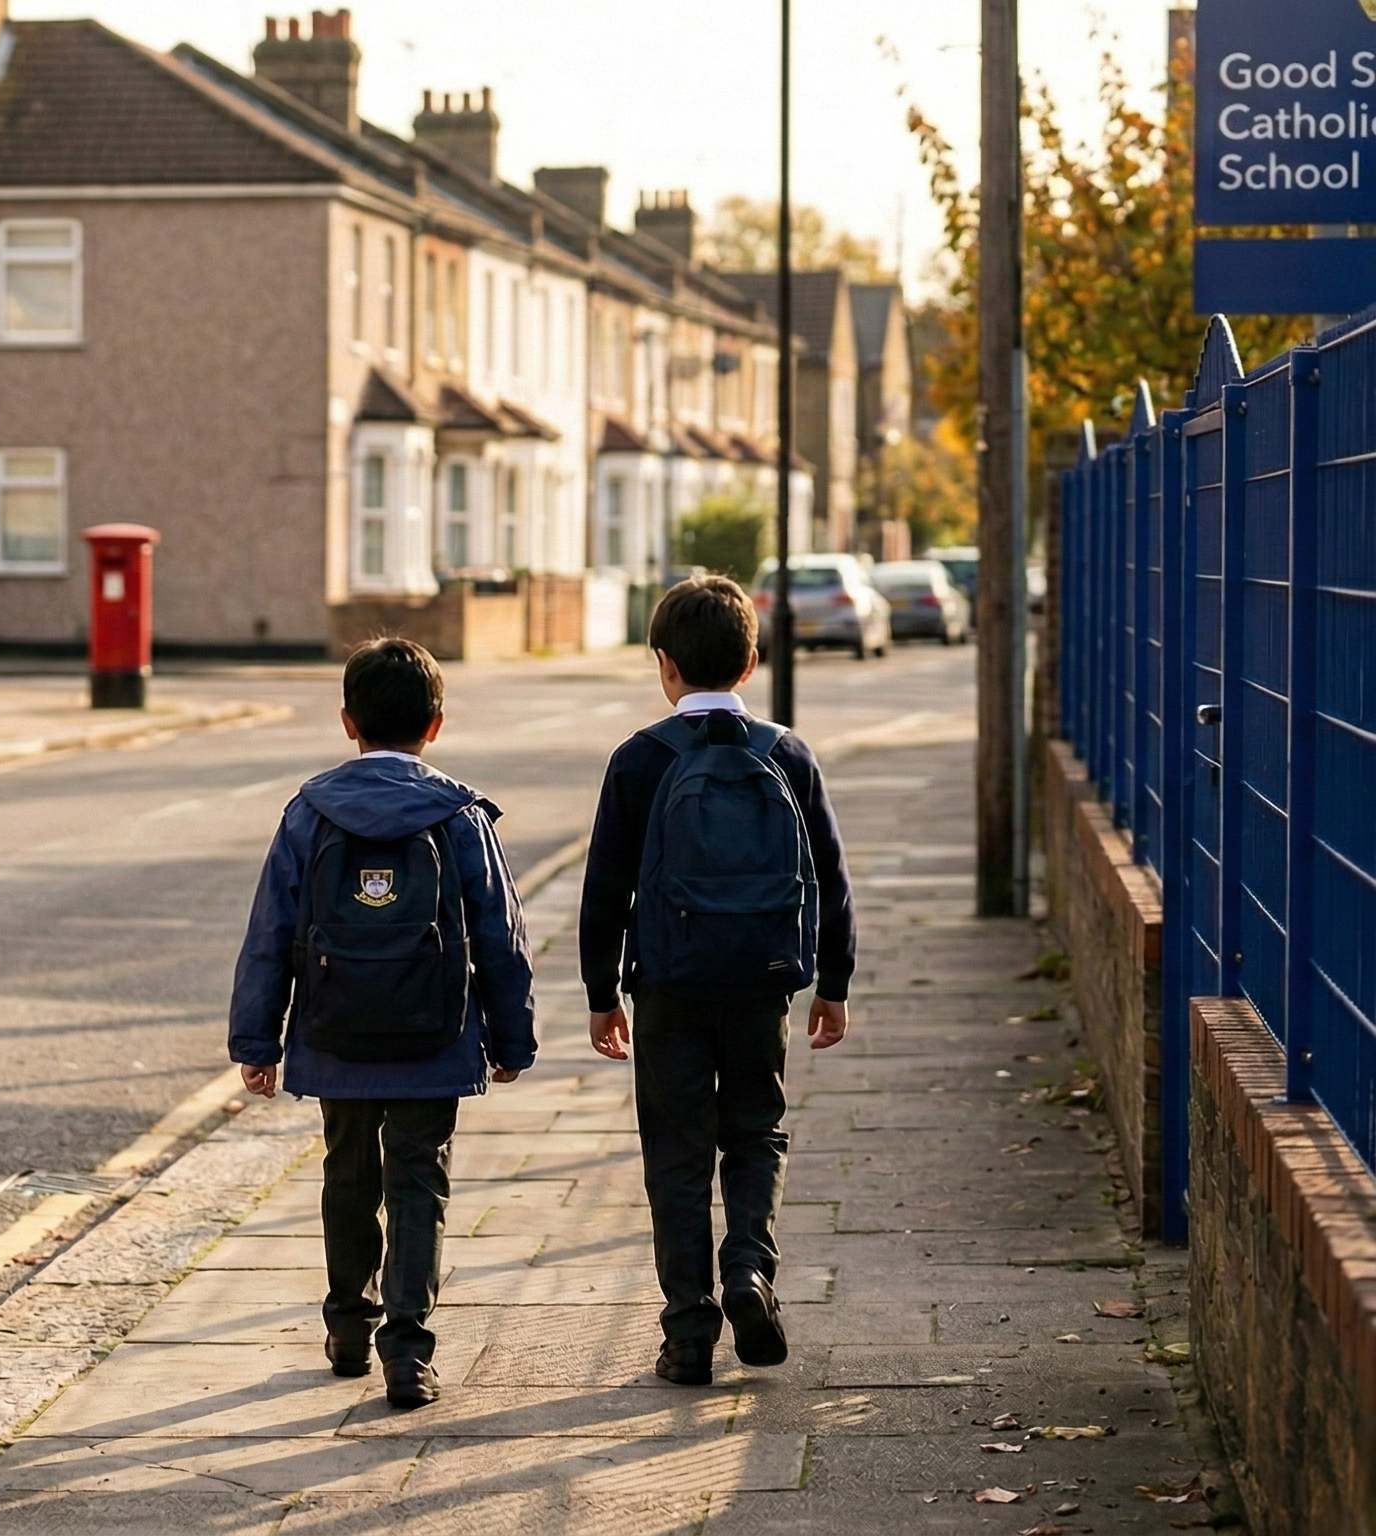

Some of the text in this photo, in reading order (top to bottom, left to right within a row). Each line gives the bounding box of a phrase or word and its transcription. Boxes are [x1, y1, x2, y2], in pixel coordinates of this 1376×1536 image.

[1219, 50, 1336, 90] Good
[1218, 101, 1376, 140] Catholi
[1218, 151, 1359, 190] School
